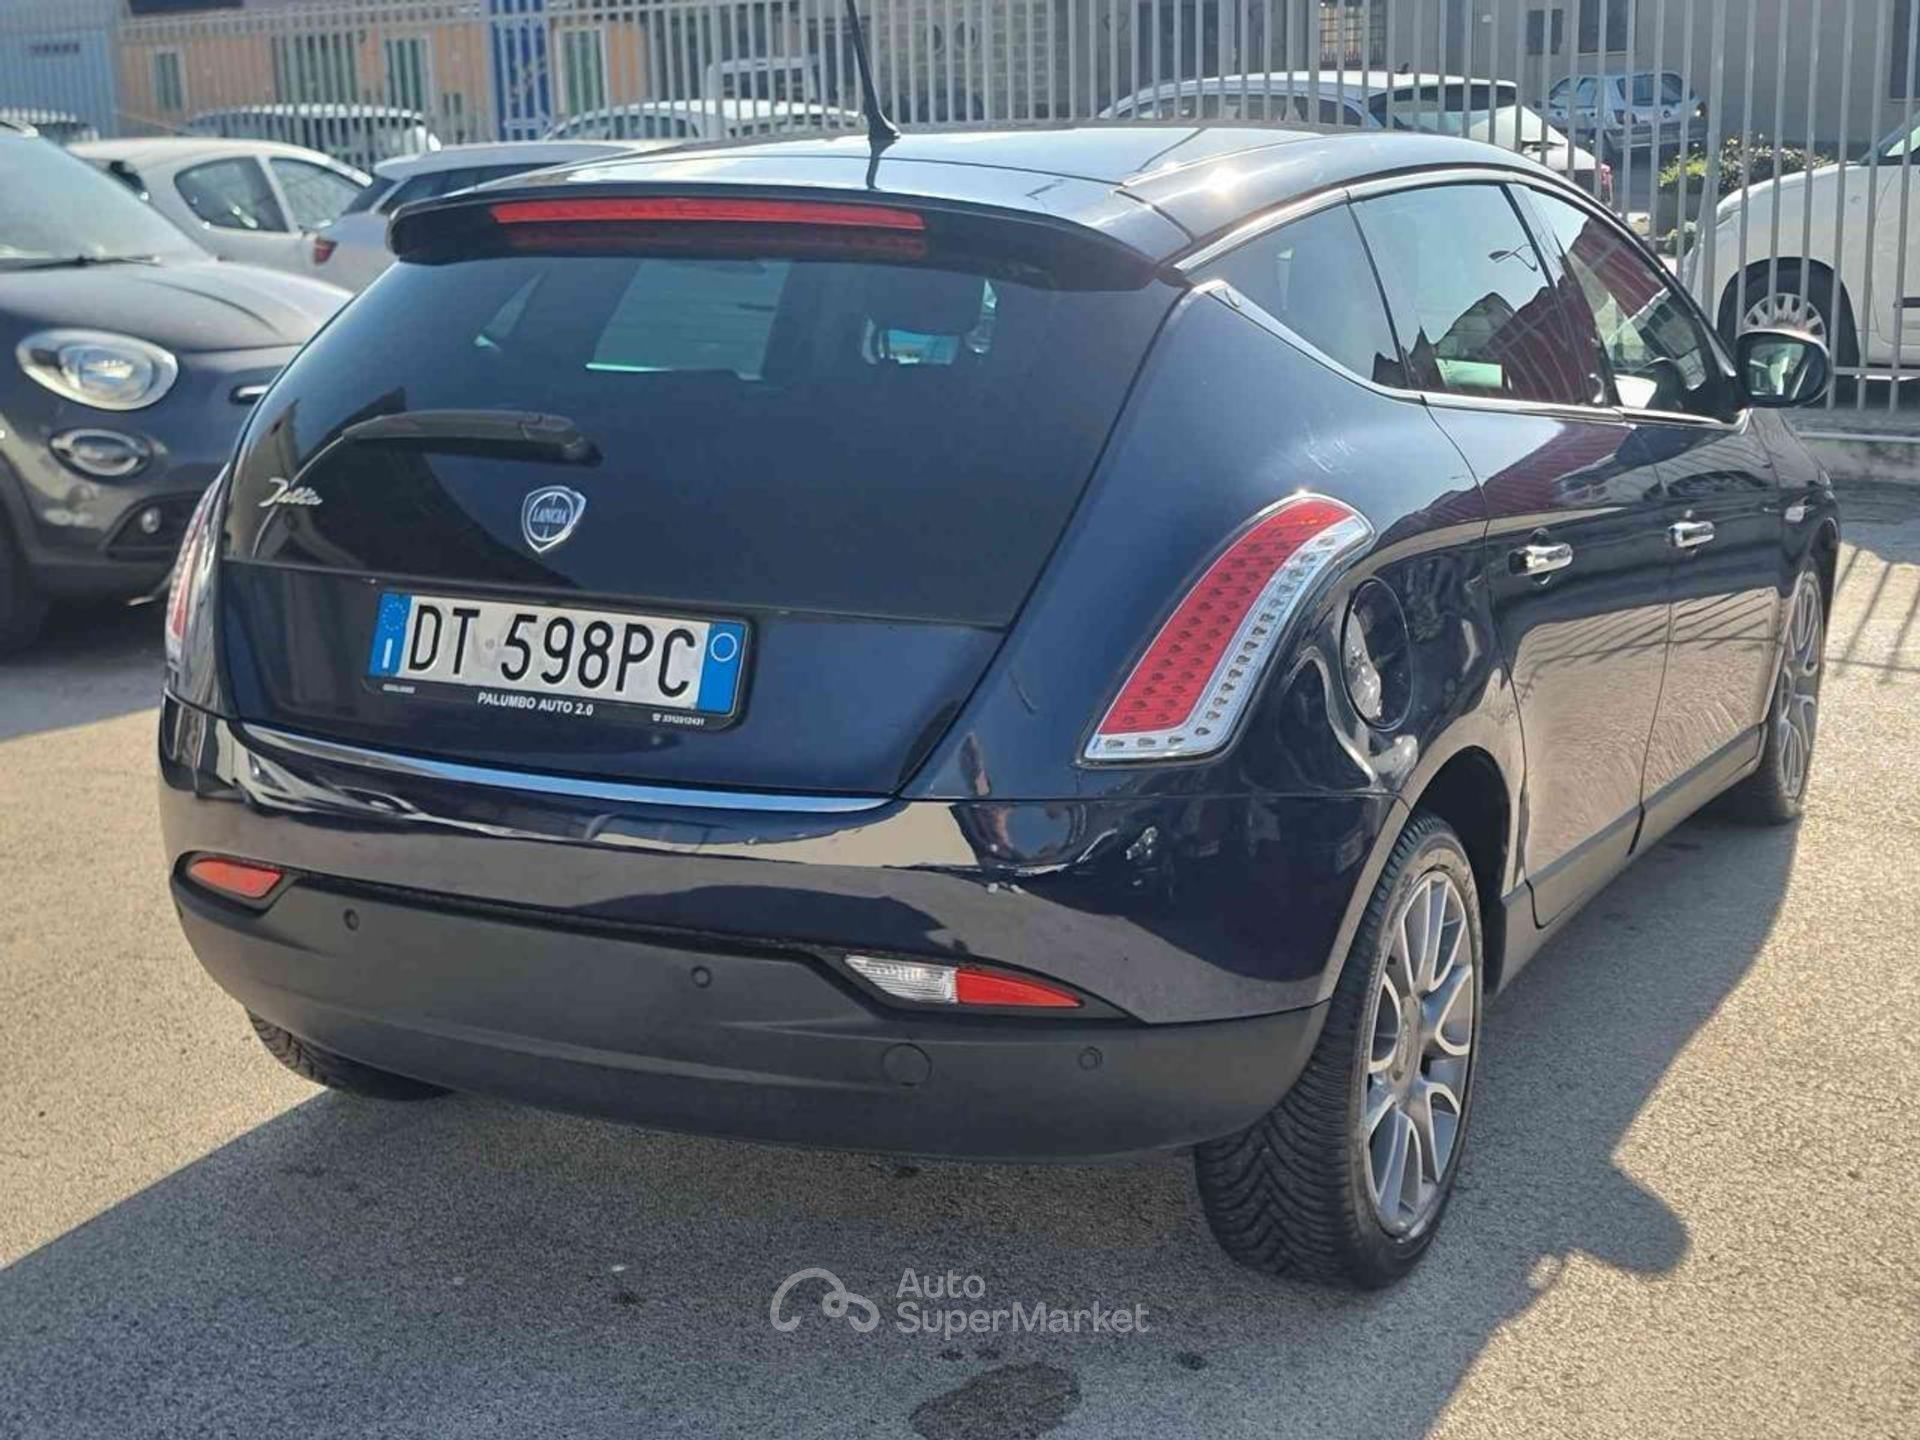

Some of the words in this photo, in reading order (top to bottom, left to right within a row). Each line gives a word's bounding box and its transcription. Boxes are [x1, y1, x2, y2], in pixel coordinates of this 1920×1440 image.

[408, 604, 481, 675] DT
[501, 614, 696, 698] 598PC
[478, 692, 536, 709] PALUMBO
[538, 699, 573, 713] AUTO
[574, 703, 594, 716] 2.0
